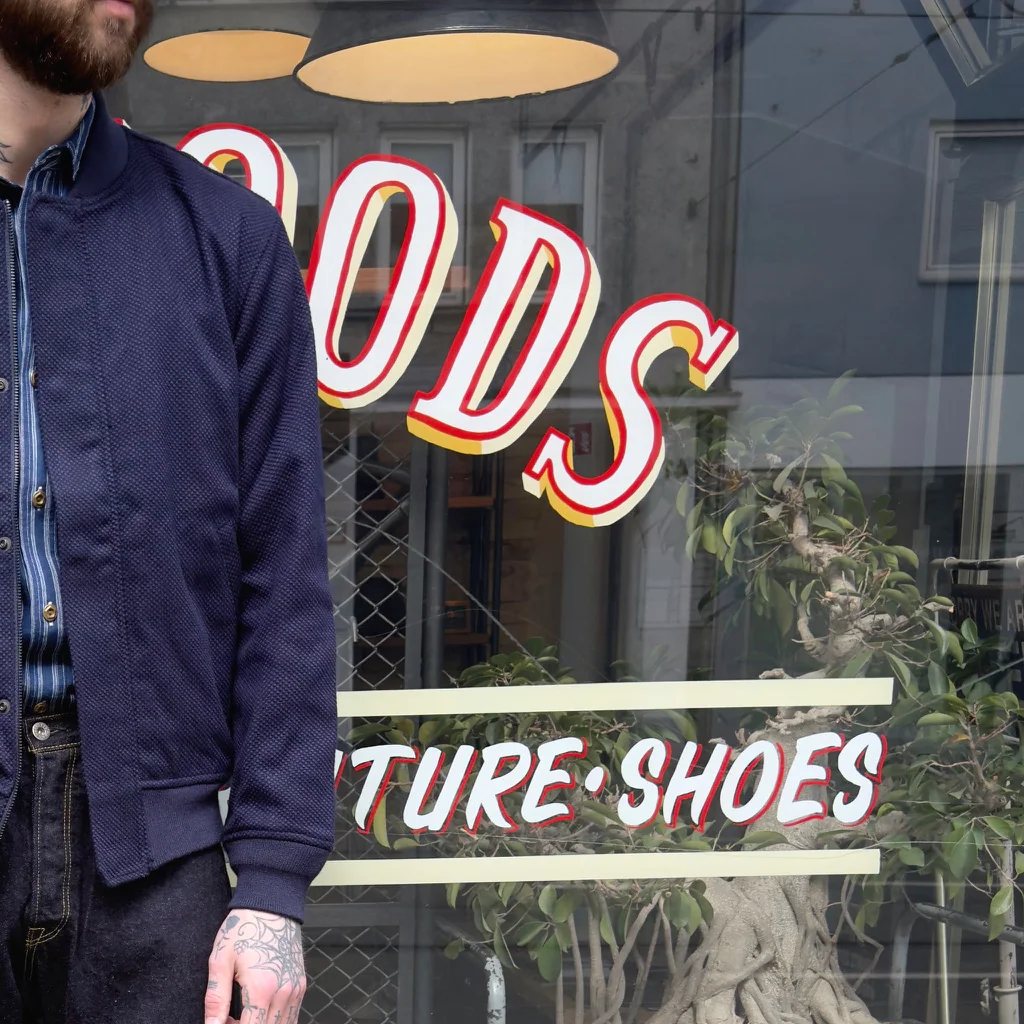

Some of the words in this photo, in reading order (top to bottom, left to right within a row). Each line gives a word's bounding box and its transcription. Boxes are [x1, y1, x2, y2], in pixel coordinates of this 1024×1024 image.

[981, 599, 1002, 631] WE
[334, 736, 588, 834] TURE
[617, 731, 888, 833] SHOES
